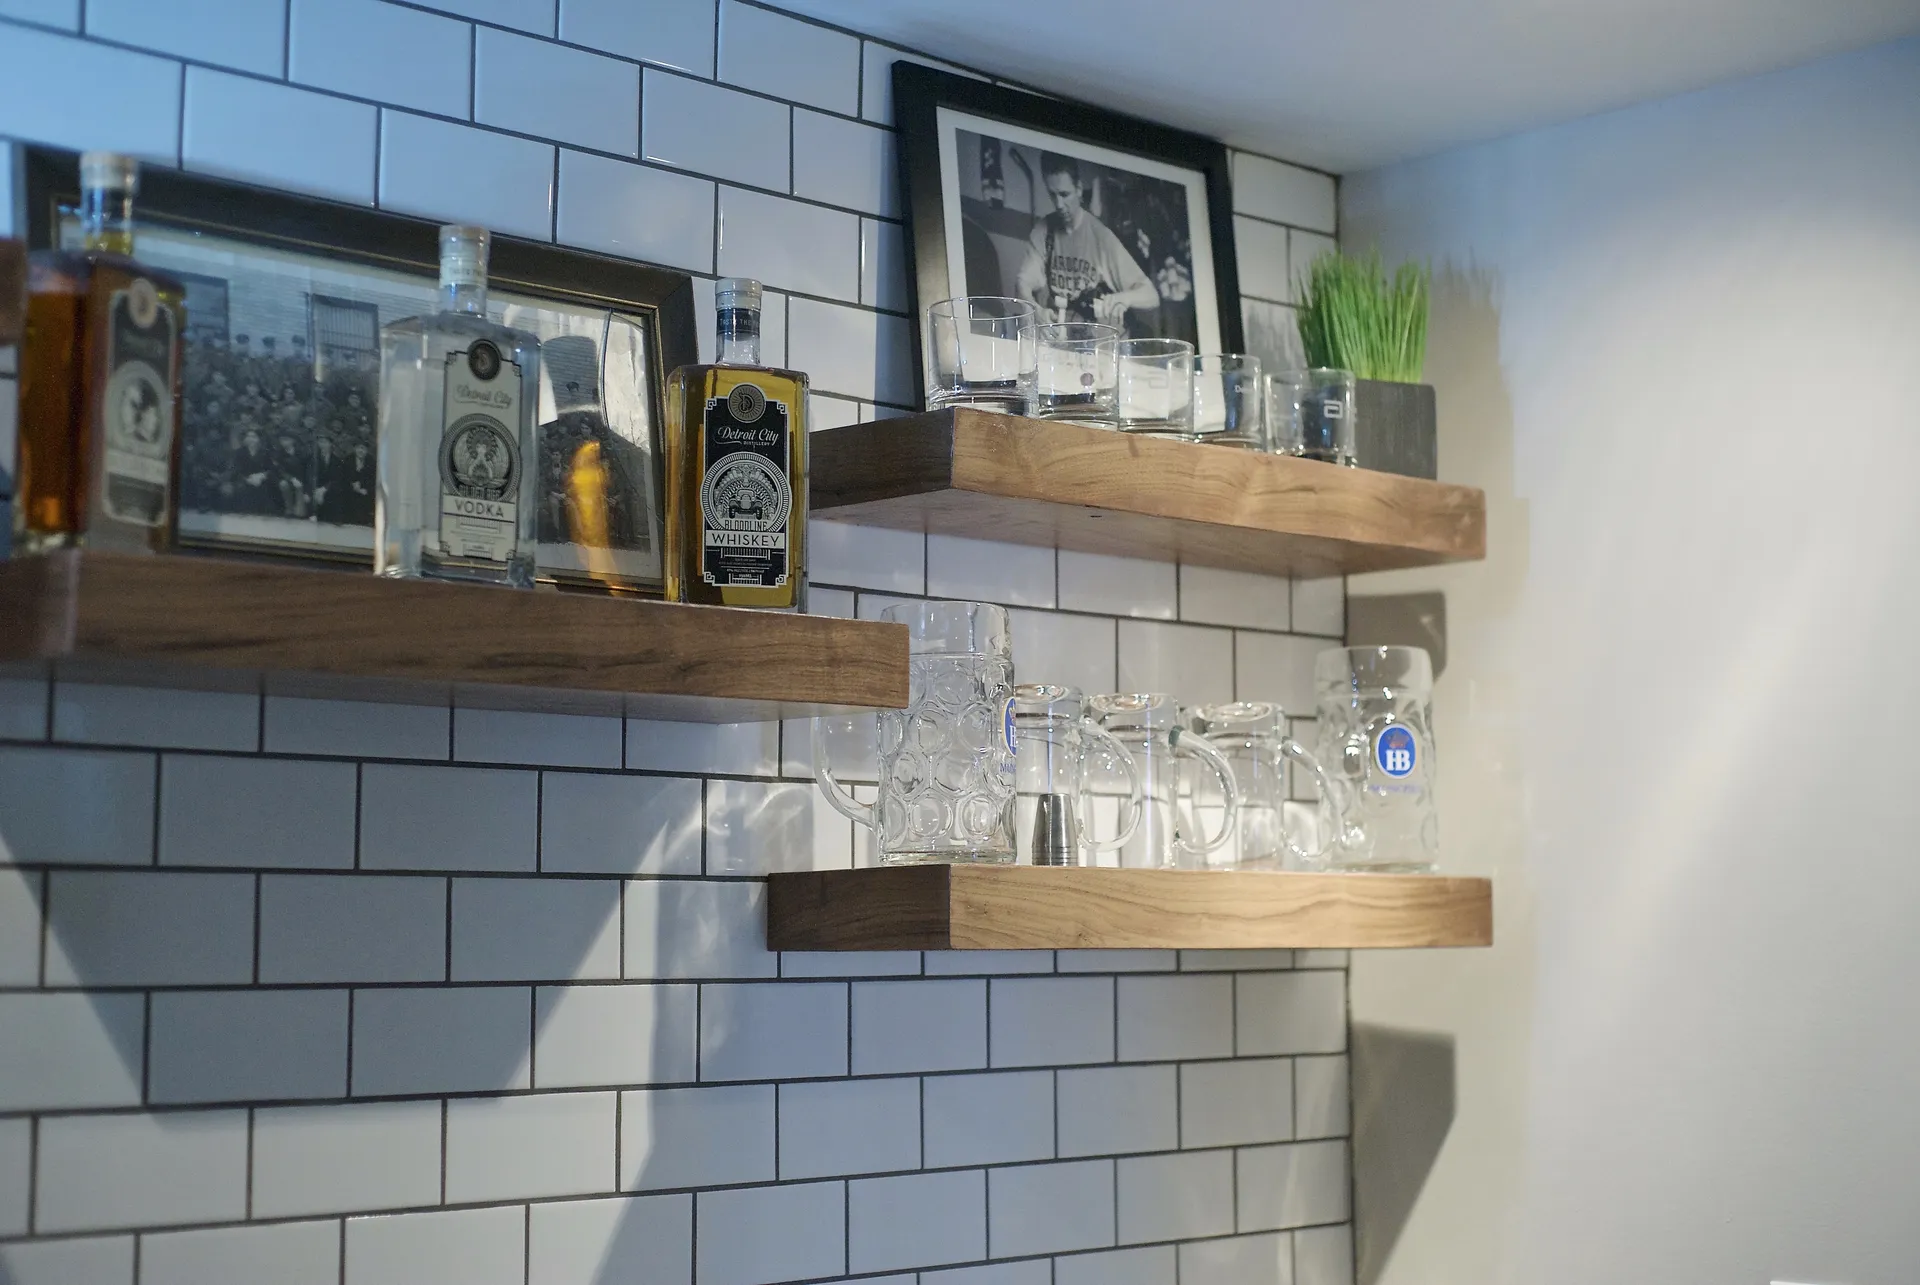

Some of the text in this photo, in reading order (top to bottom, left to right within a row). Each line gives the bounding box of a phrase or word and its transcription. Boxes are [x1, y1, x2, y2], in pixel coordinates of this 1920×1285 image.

[717, 425, 779, 446] Detroit City
[454, 499, 505, 517] VODKA
[724, 519, 768, 532] BLOODLINE
[711, 533, 780, 547] WHISKEY
[1385, 749, 1411, 771] HB
